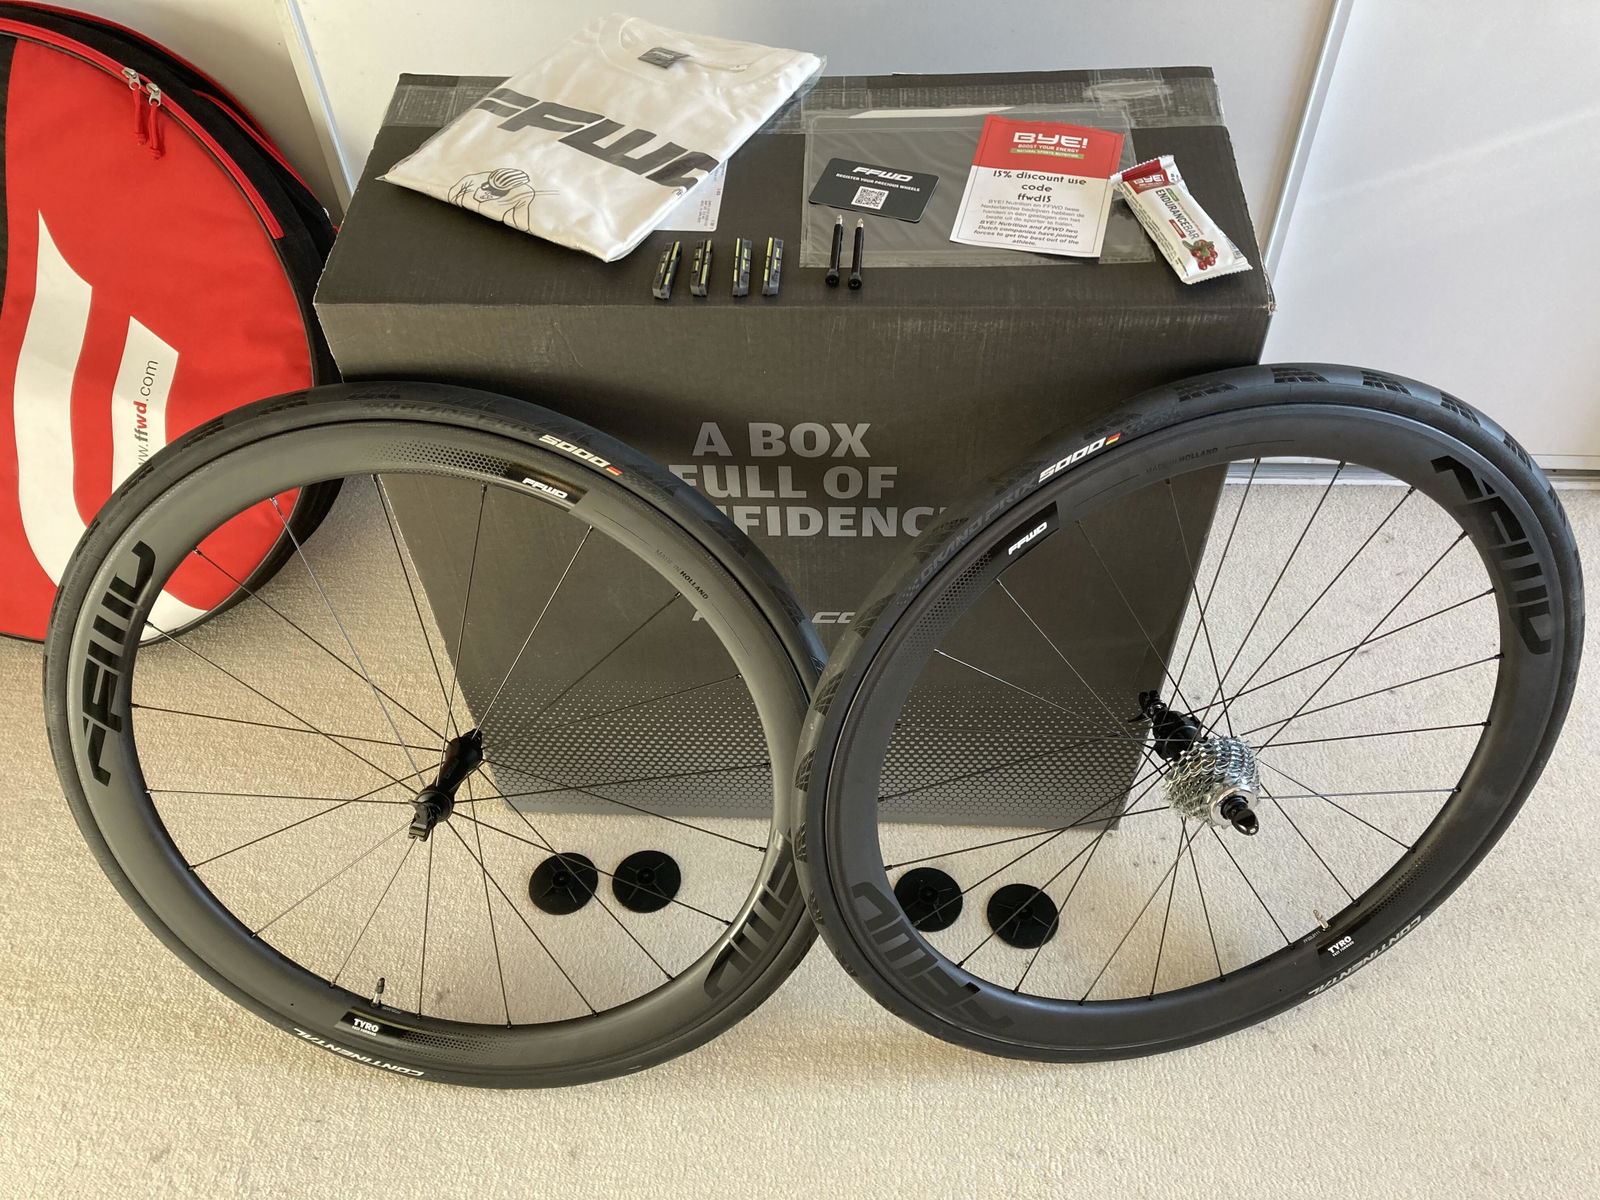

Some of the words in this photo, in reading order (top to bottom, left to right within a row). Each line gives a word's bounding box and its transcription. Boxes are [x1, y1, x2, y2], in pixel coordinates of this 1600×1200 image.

[1013, 132, 1088, 149] BYE!
[835, 172, 860, 181] REGISTER
[874, 180, 899, 188] PRECIOUS
[899, 184, 920, 192] WHEELS
[852, 166, 914, 182] FFWD
[993, 170, 1012, 178] 15%
[1016, 172, 1064, 183] discount
[1068, 177, 1087, 185] use
[1021, 182, 1053, 192] code
[1017, 193, 1052, 203] ffwd15
[999, 227, 1036, 235] companies
[134, 360, 159, 465] w.ffwd.com
[692, 421, 733, 457] A
[748, 422, 871, 458] BOX
[539, 434, 611, 469] 5000
[1038, 437, 1107, 483] 5000
[1178, 447, 1219, 462] HOLLAND
[522, 477, 569, 499] FFWD
[668, 464, 807, 499] FULL
[823, 466, 898, 499] OF
[715, 505, 948, 537] FIDENC
[1008, 521, 1048, 556] FFWD
[680, 570, 709, 600] HOLLAND
[1327, 936, 1352, 954] TYRO
[354, 1018, 379, 1033] TYRO
